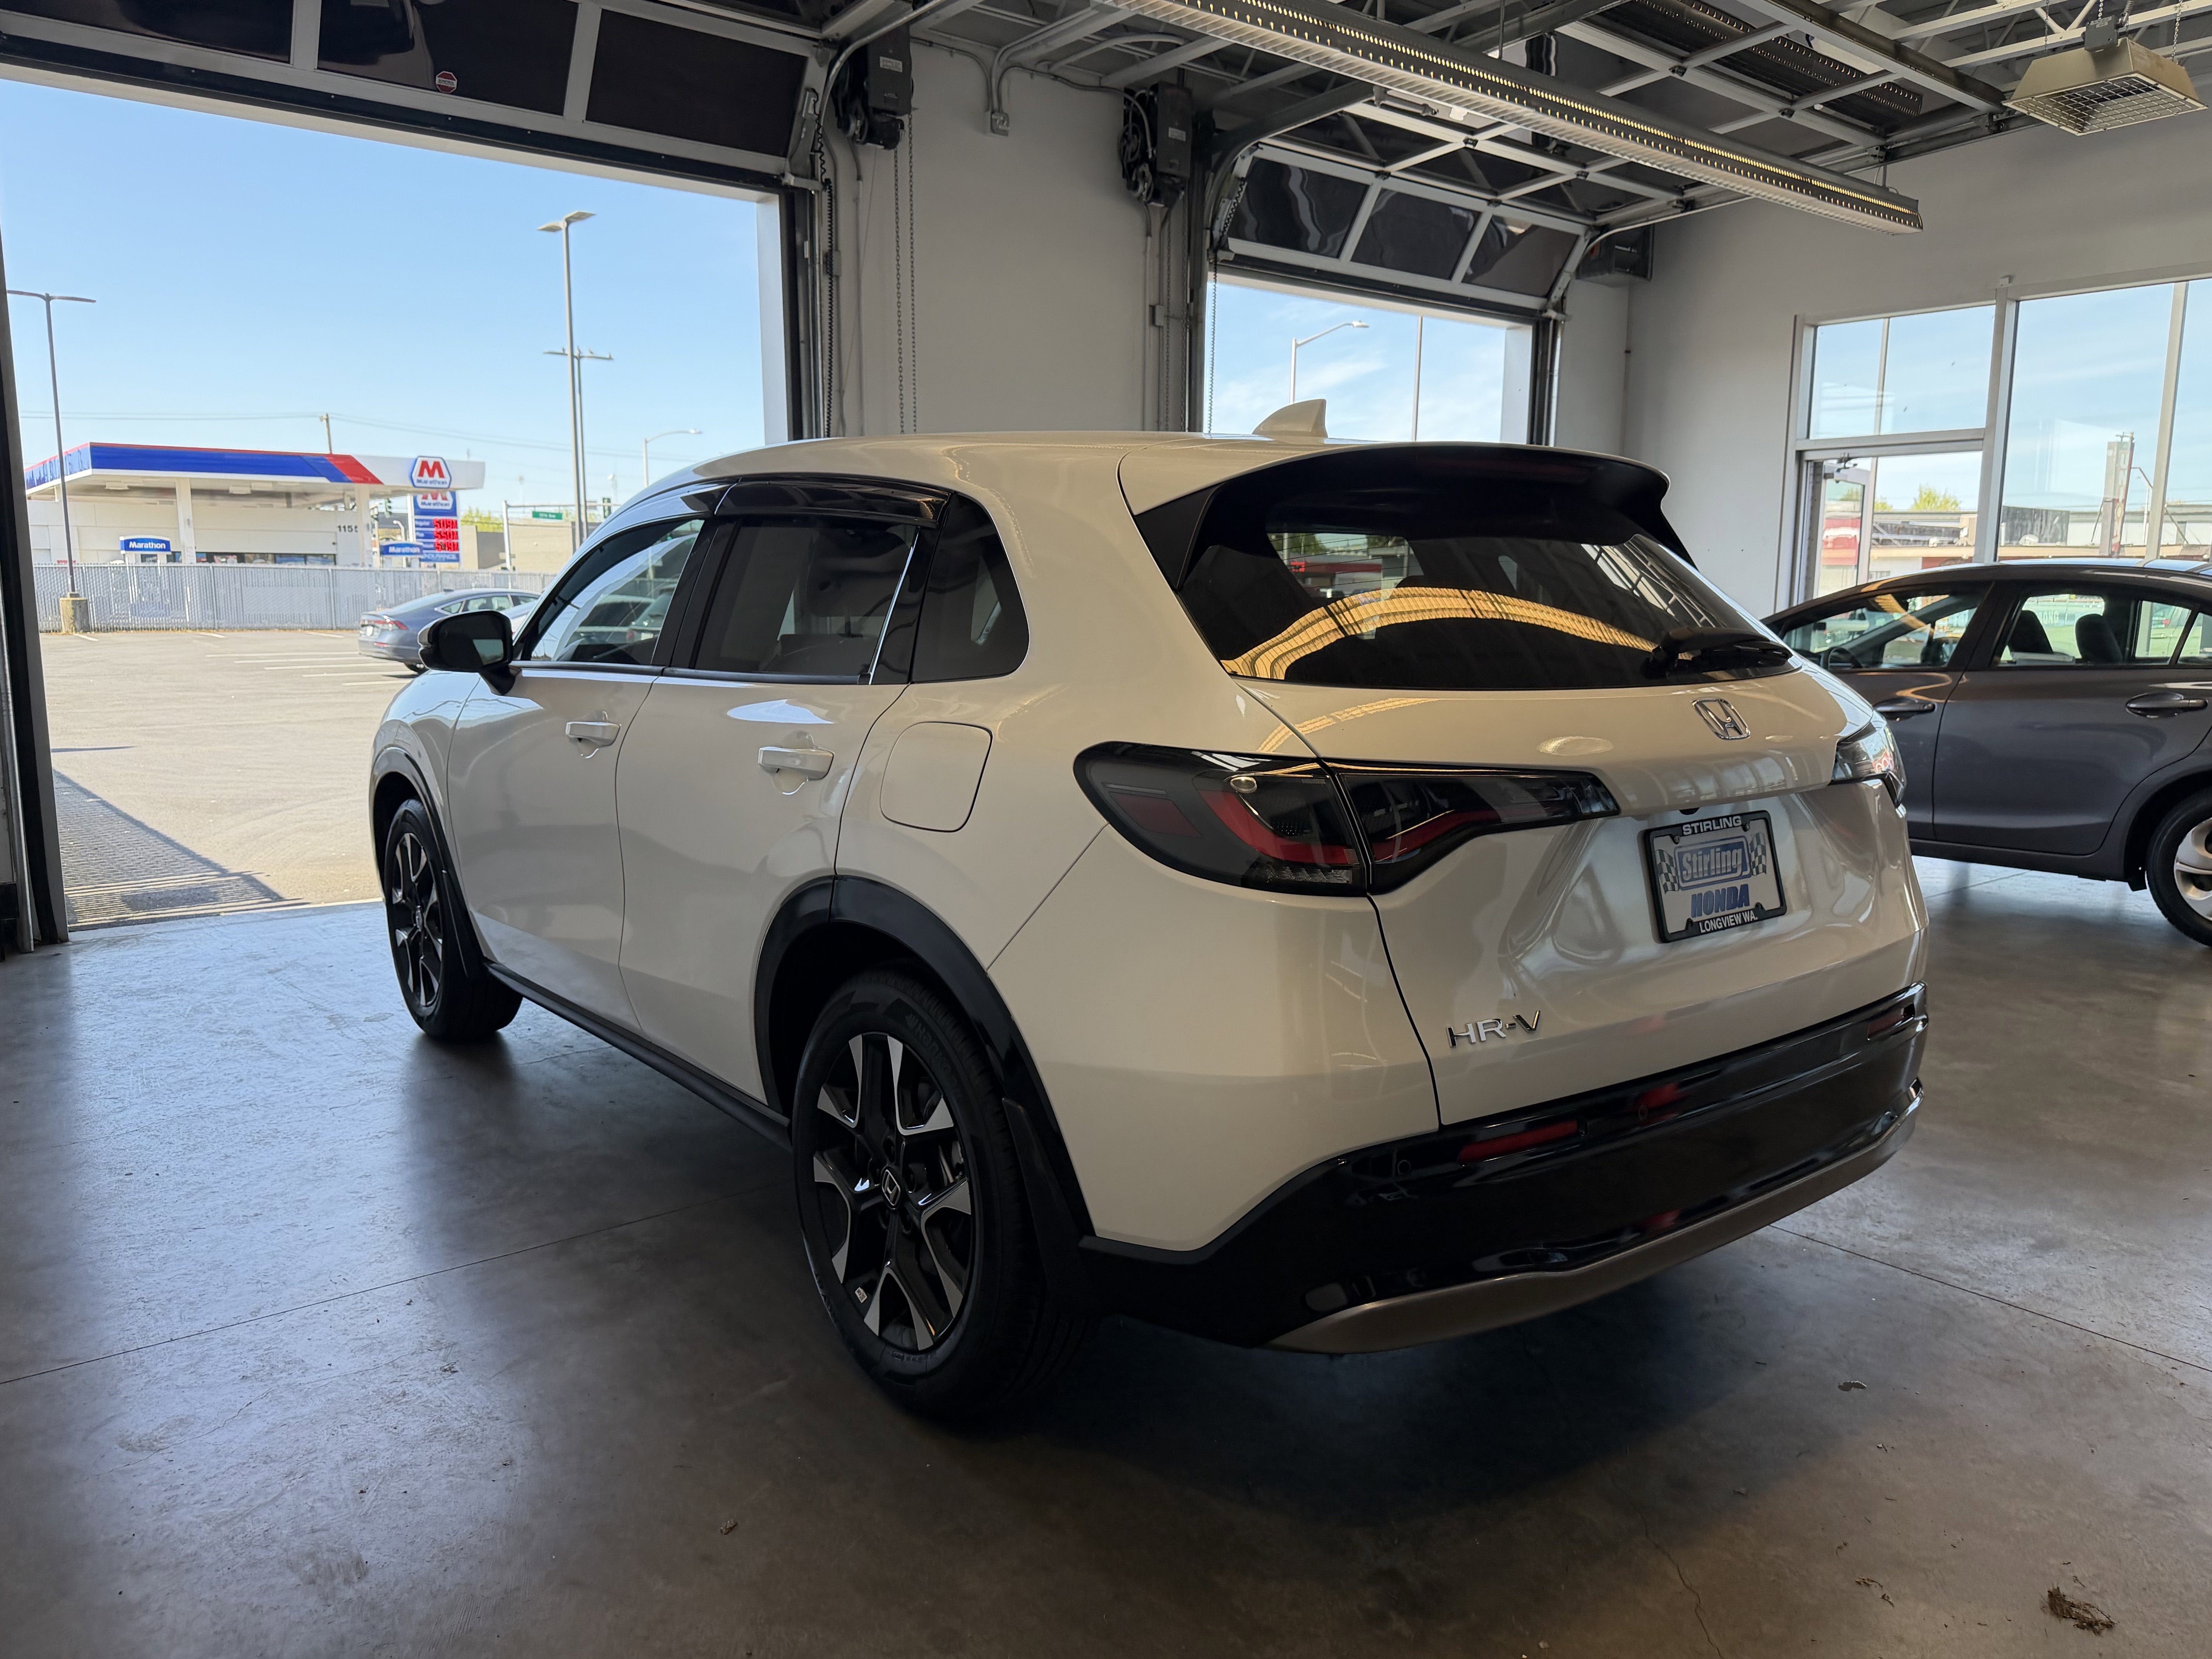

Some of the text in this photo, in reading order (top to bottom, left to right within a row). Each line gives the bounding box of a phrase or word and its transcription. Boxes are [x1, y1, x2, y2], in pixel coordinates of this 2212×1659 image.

[1682, 816, 1742, 835] STIRLING
[1682, 848, 1743, 881] Stirling
[1691, 884, 1750, 918] HONDA
[1699, 914, 1743, 933] LONGVIEW
[1446, 1010, 1541, 1048] HR-V
